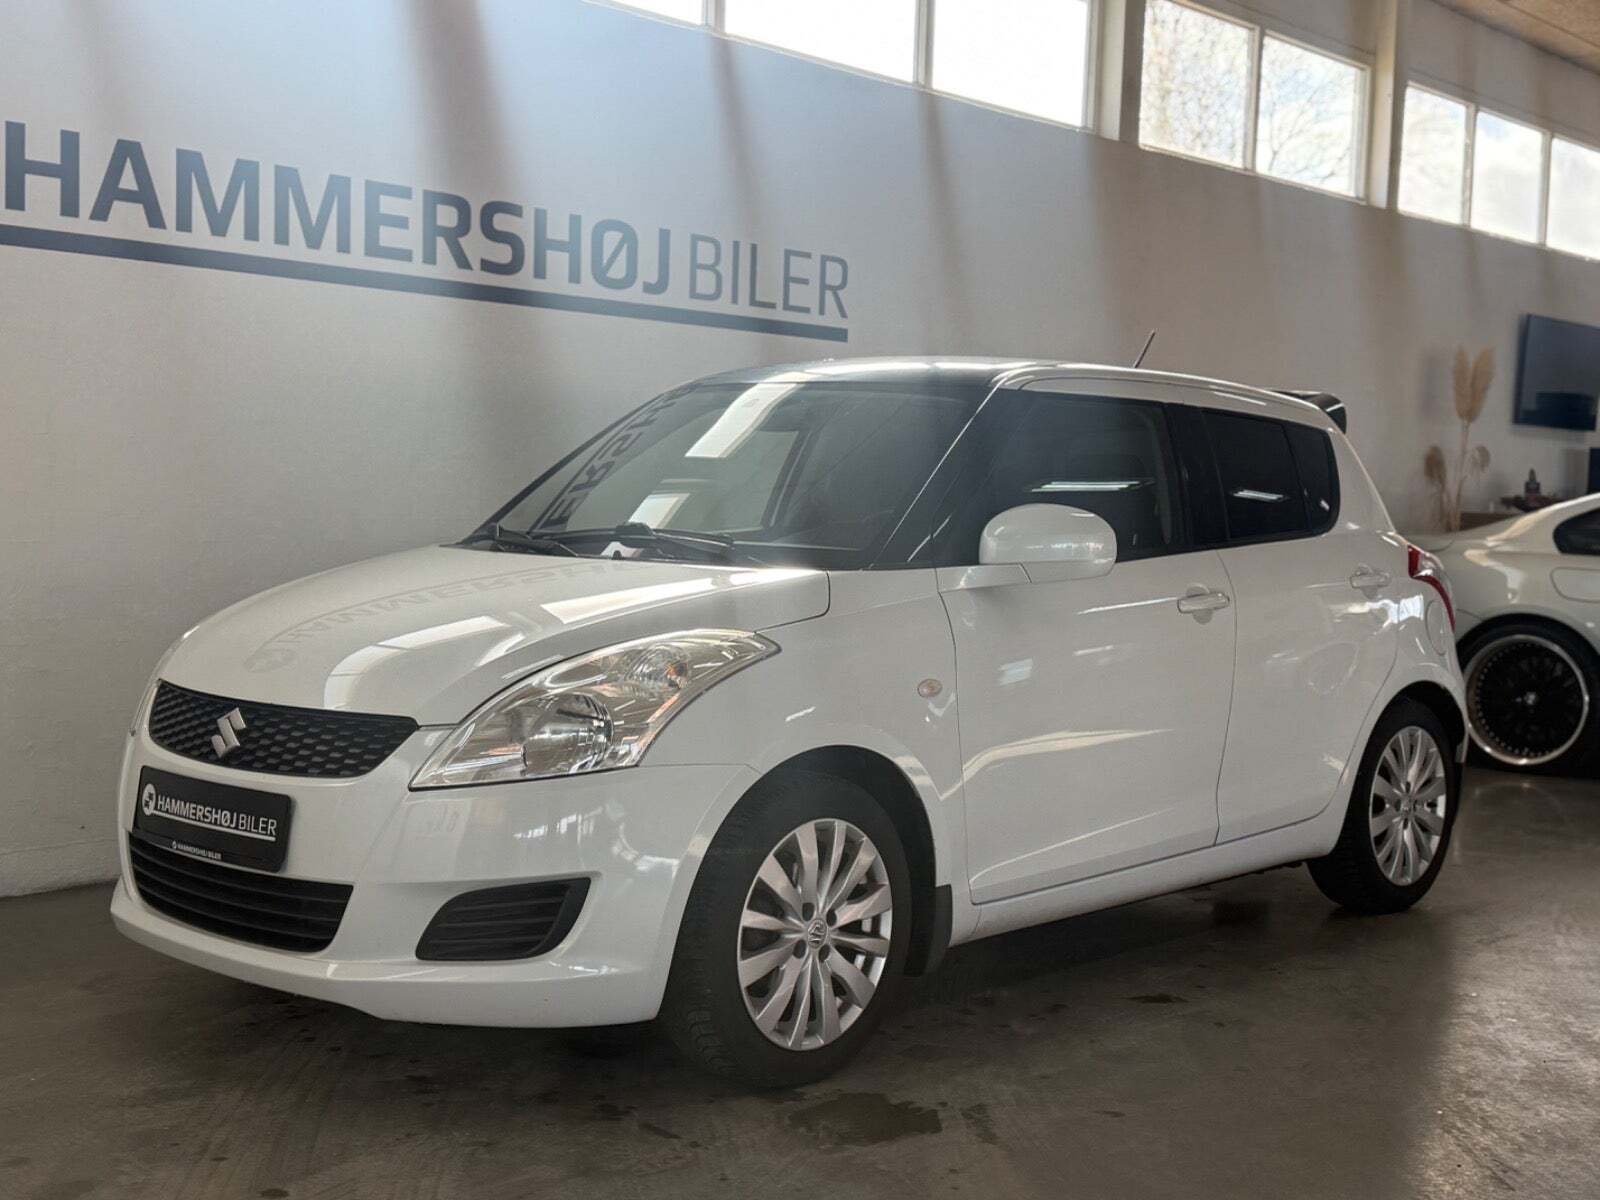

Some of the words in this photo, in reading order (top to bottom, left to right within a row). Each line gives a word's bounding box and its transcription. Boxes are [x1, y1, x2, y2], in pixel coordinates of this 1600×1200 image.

[5, 121, 671, 296] HAMMERSHØJ
[689, 232, 848, 319] BILER
[157, 795, 238, 828] HAMMERSHØJ
[238, 813, 278, 836] BILER
